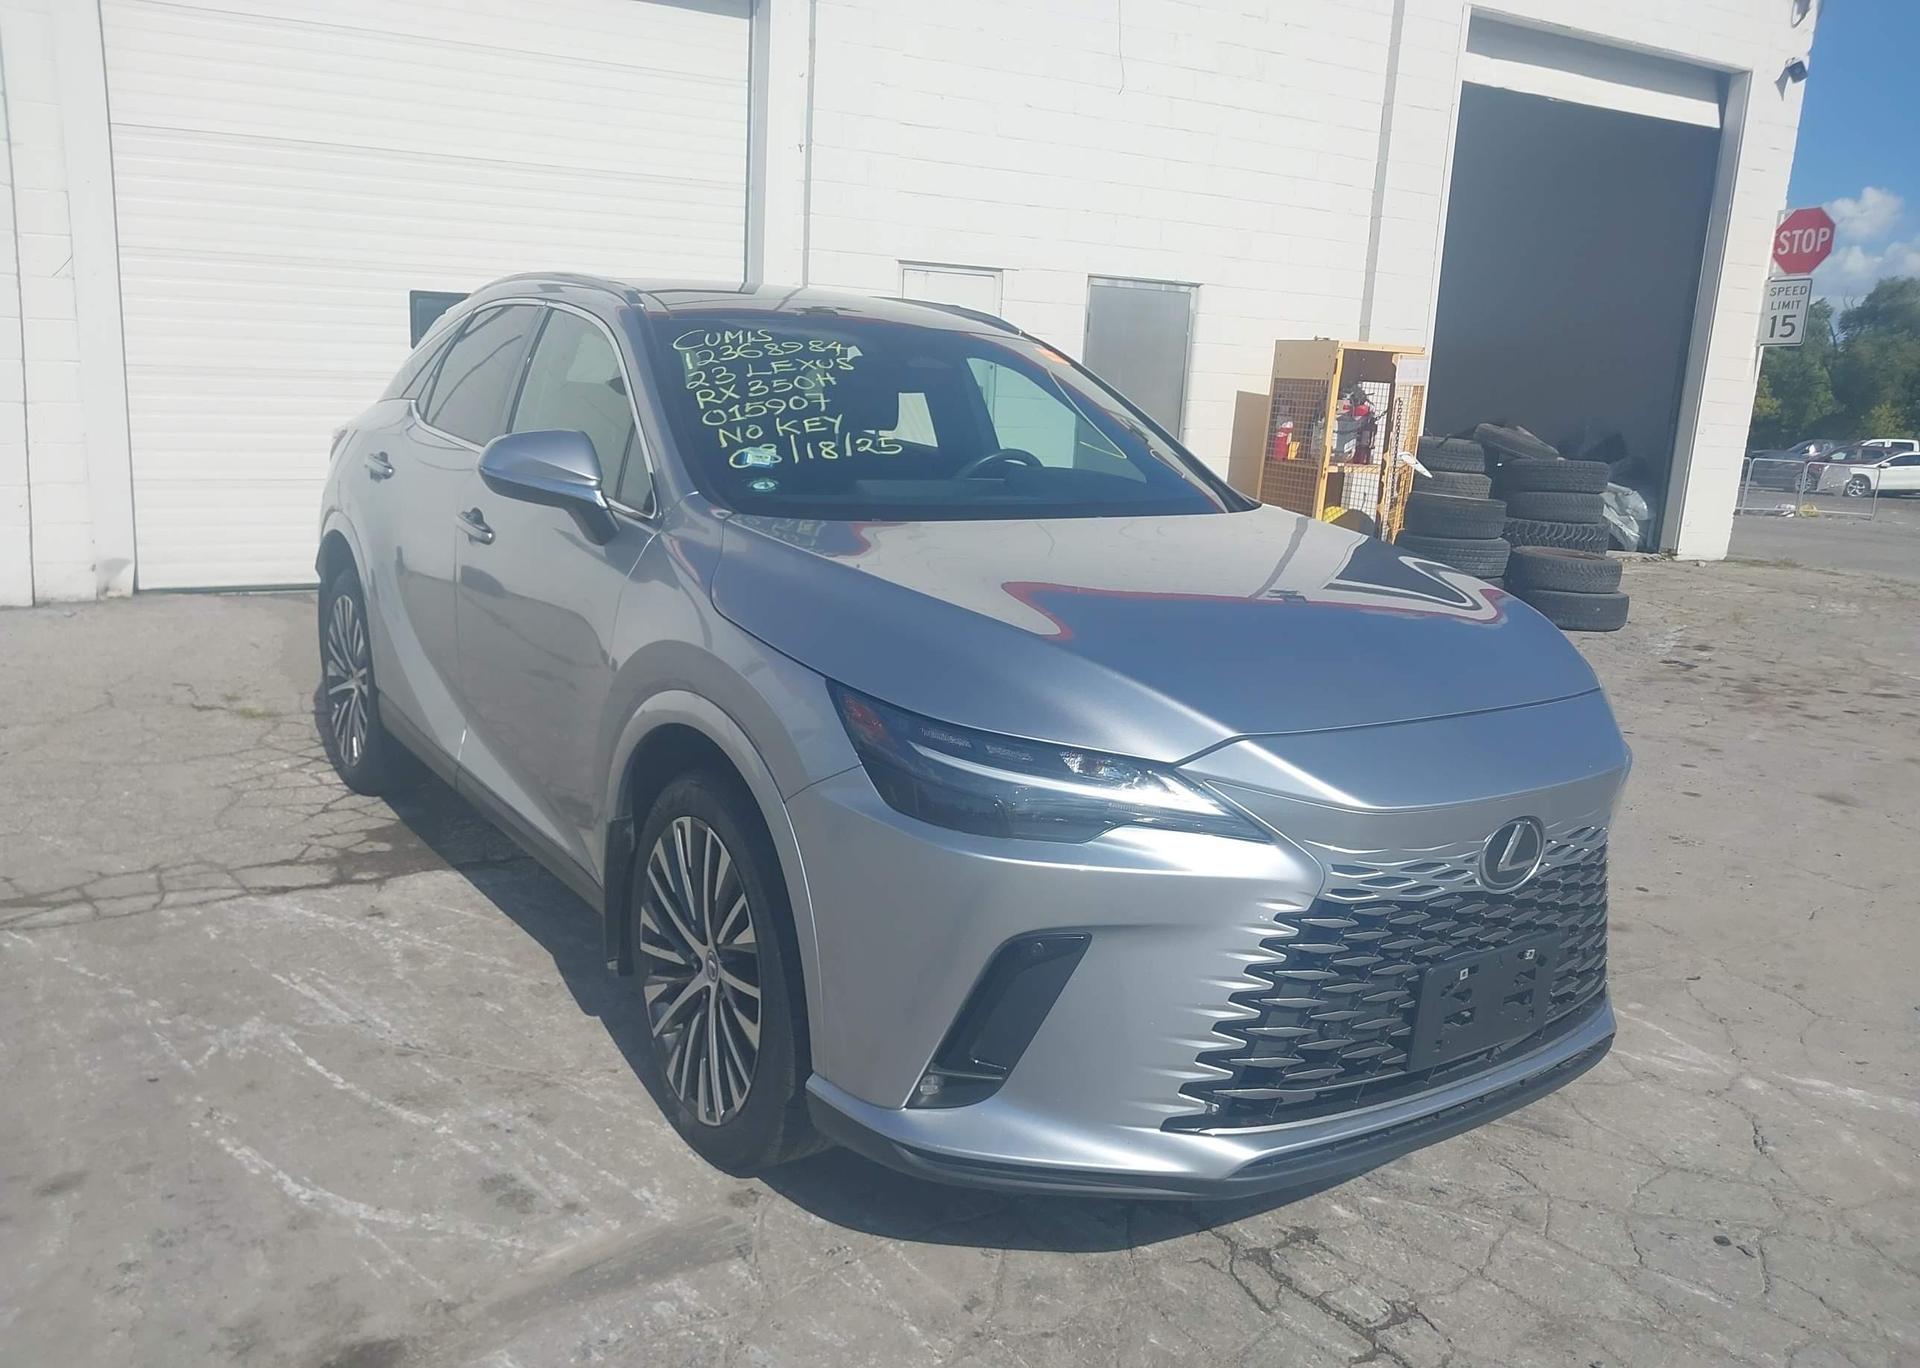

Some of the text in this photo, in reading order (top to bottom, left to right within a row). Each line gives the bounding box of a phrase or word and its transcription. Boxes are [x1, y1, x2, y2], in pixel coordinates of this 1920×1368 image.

[1777, 227, 1831, 256] STOP
[1769, 285, 1808, 297] SPEED
[1770, 299, 1802, 311] LIMIT
[1768, 314, 1797, 339] 15
[673, 329, 773, 351] CUMIS
[686, 358, 855, 389] 23 LEXUS
[696, 384, 741, 409] RX
[702, 393, 831, 425] 015907
[775, 414, 842, 436] KEY
